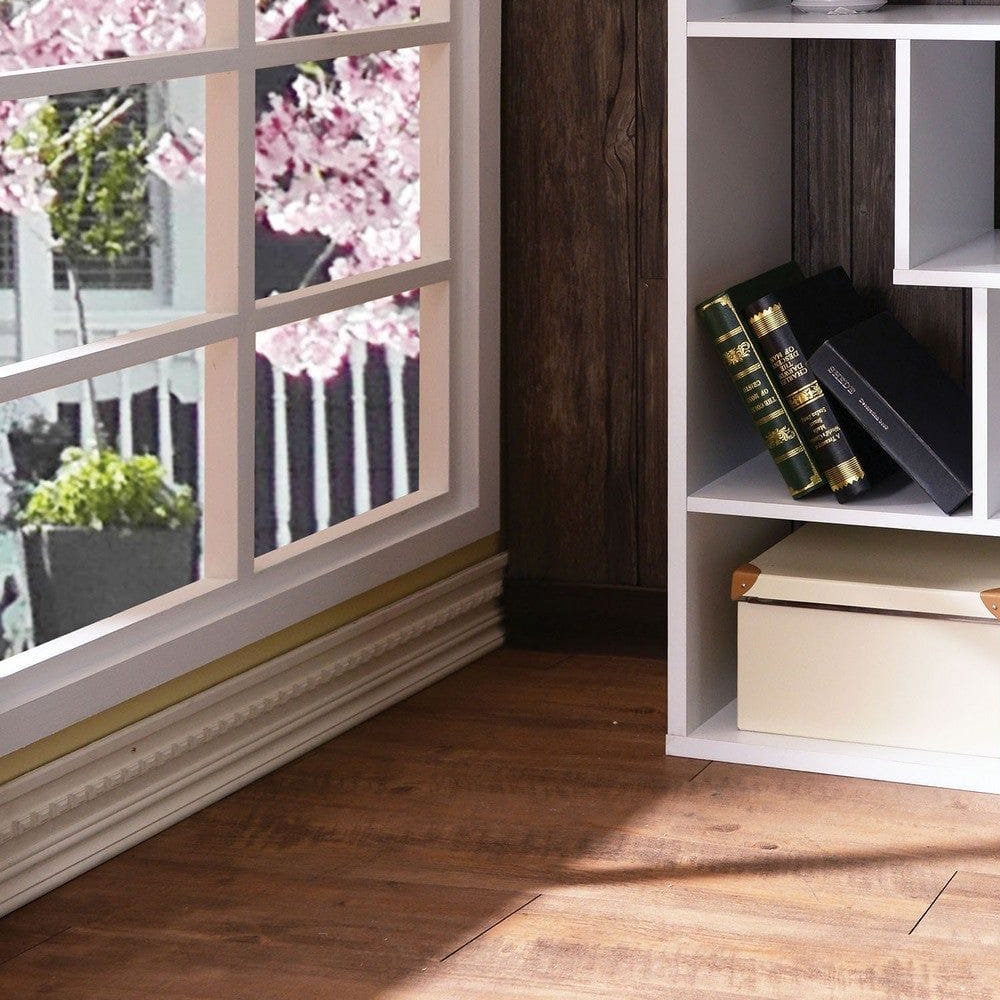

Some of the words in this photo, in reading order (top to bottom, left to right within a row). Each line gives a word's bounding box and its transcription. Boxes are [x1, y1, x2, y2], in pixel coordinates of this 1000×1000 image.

[784, 345, 795, 356] OF
[780, 361, 794, 372] THE
[760, 388, 769, 397] OF
[763, 396, 777, 407] THE
